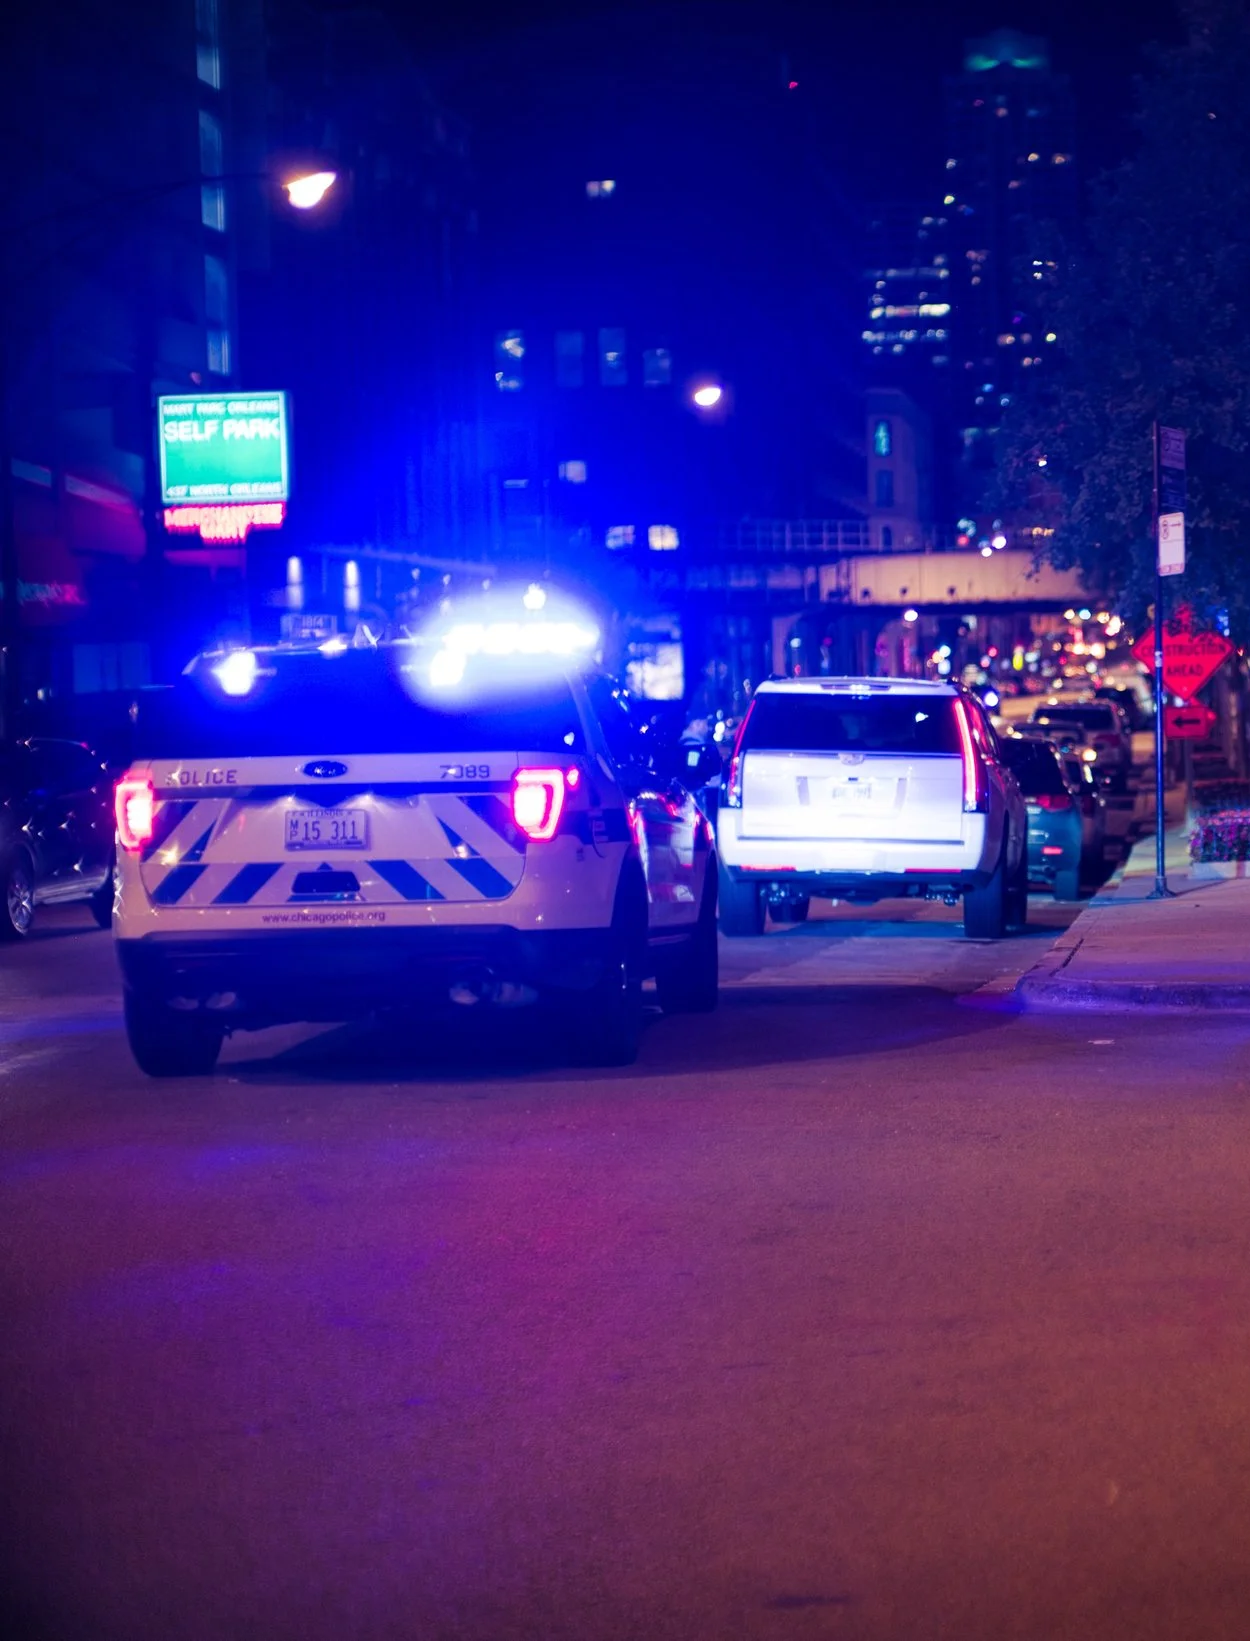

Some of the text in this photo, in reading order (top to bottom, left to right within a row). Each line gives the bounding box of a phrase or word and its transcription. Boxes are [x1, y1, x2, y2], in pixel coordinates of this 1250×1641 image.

[164, 417, 280, 443] SELF PARK
[1141, 643, 1226, 656] COSTRUCTION
[1167, 663, 1203, 676] AHEAD
[302, 820, 321, 841] 15
[331, 820, 358, 841] 311
